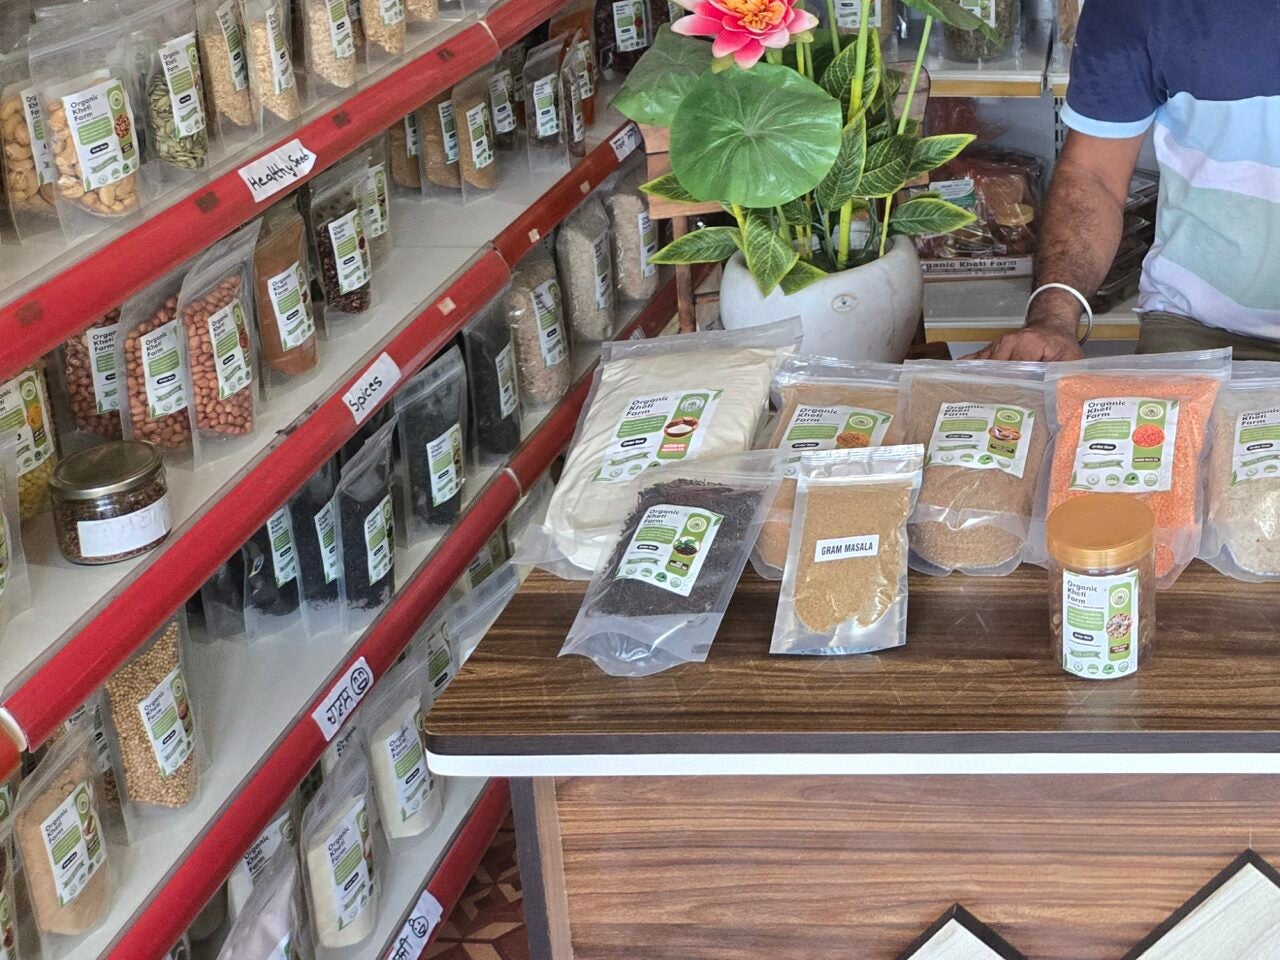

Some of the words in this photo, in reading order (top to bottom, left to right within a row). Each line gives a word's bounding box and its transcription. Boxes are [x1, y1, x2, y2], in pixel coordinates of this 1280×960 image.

[71, 95, 99, 109] Organic
[72, 104, 92, 116] Kheti
[74, 112, 94, 122] Farm
[960, 260, 986, 268] Kheti
[146, 331, 168, 346] Organic
[146, 341, 163, 351] Kheti
[147, 347, 164, 358] Farm
[350, 376, 383, 413] Spices
[632, 396, 669, 406] Organic
[630, 403, 653, 411] Kheti
[1087, 406, 1112, 414] Kheti
[1088, 400, 1126, 409] Organic
[1086, 411, 1111, 420] Farm
[1243, 408, 1280, 417] Organic
[822, 545, 843, 557] GRAM
[844, 542, 873, 555] MASALA
[1067, 580, 1098, 593] Organic
[1068, 588, 1087, 598] Kheti
[1067, 594, 1086, 604] Farm
[144, 692, 165, 711] Organic
[146, 702, 161, 717] Kheti
[148, 709, 163, 722] Farm
[45, 809, 68, 832] Organic
[47, 822, 62, 838] Kheti
[49, 829, 64, 843] Farm
[329, 826, 350, 851] Organic
[243, 835, 270, 860] Organic
[330, 839, 345, 858] Kheti
[247, 849, 263, 866] Kheti
[332, 847, 347, 865] Farm
[249, 856, 265, 873] Farm
